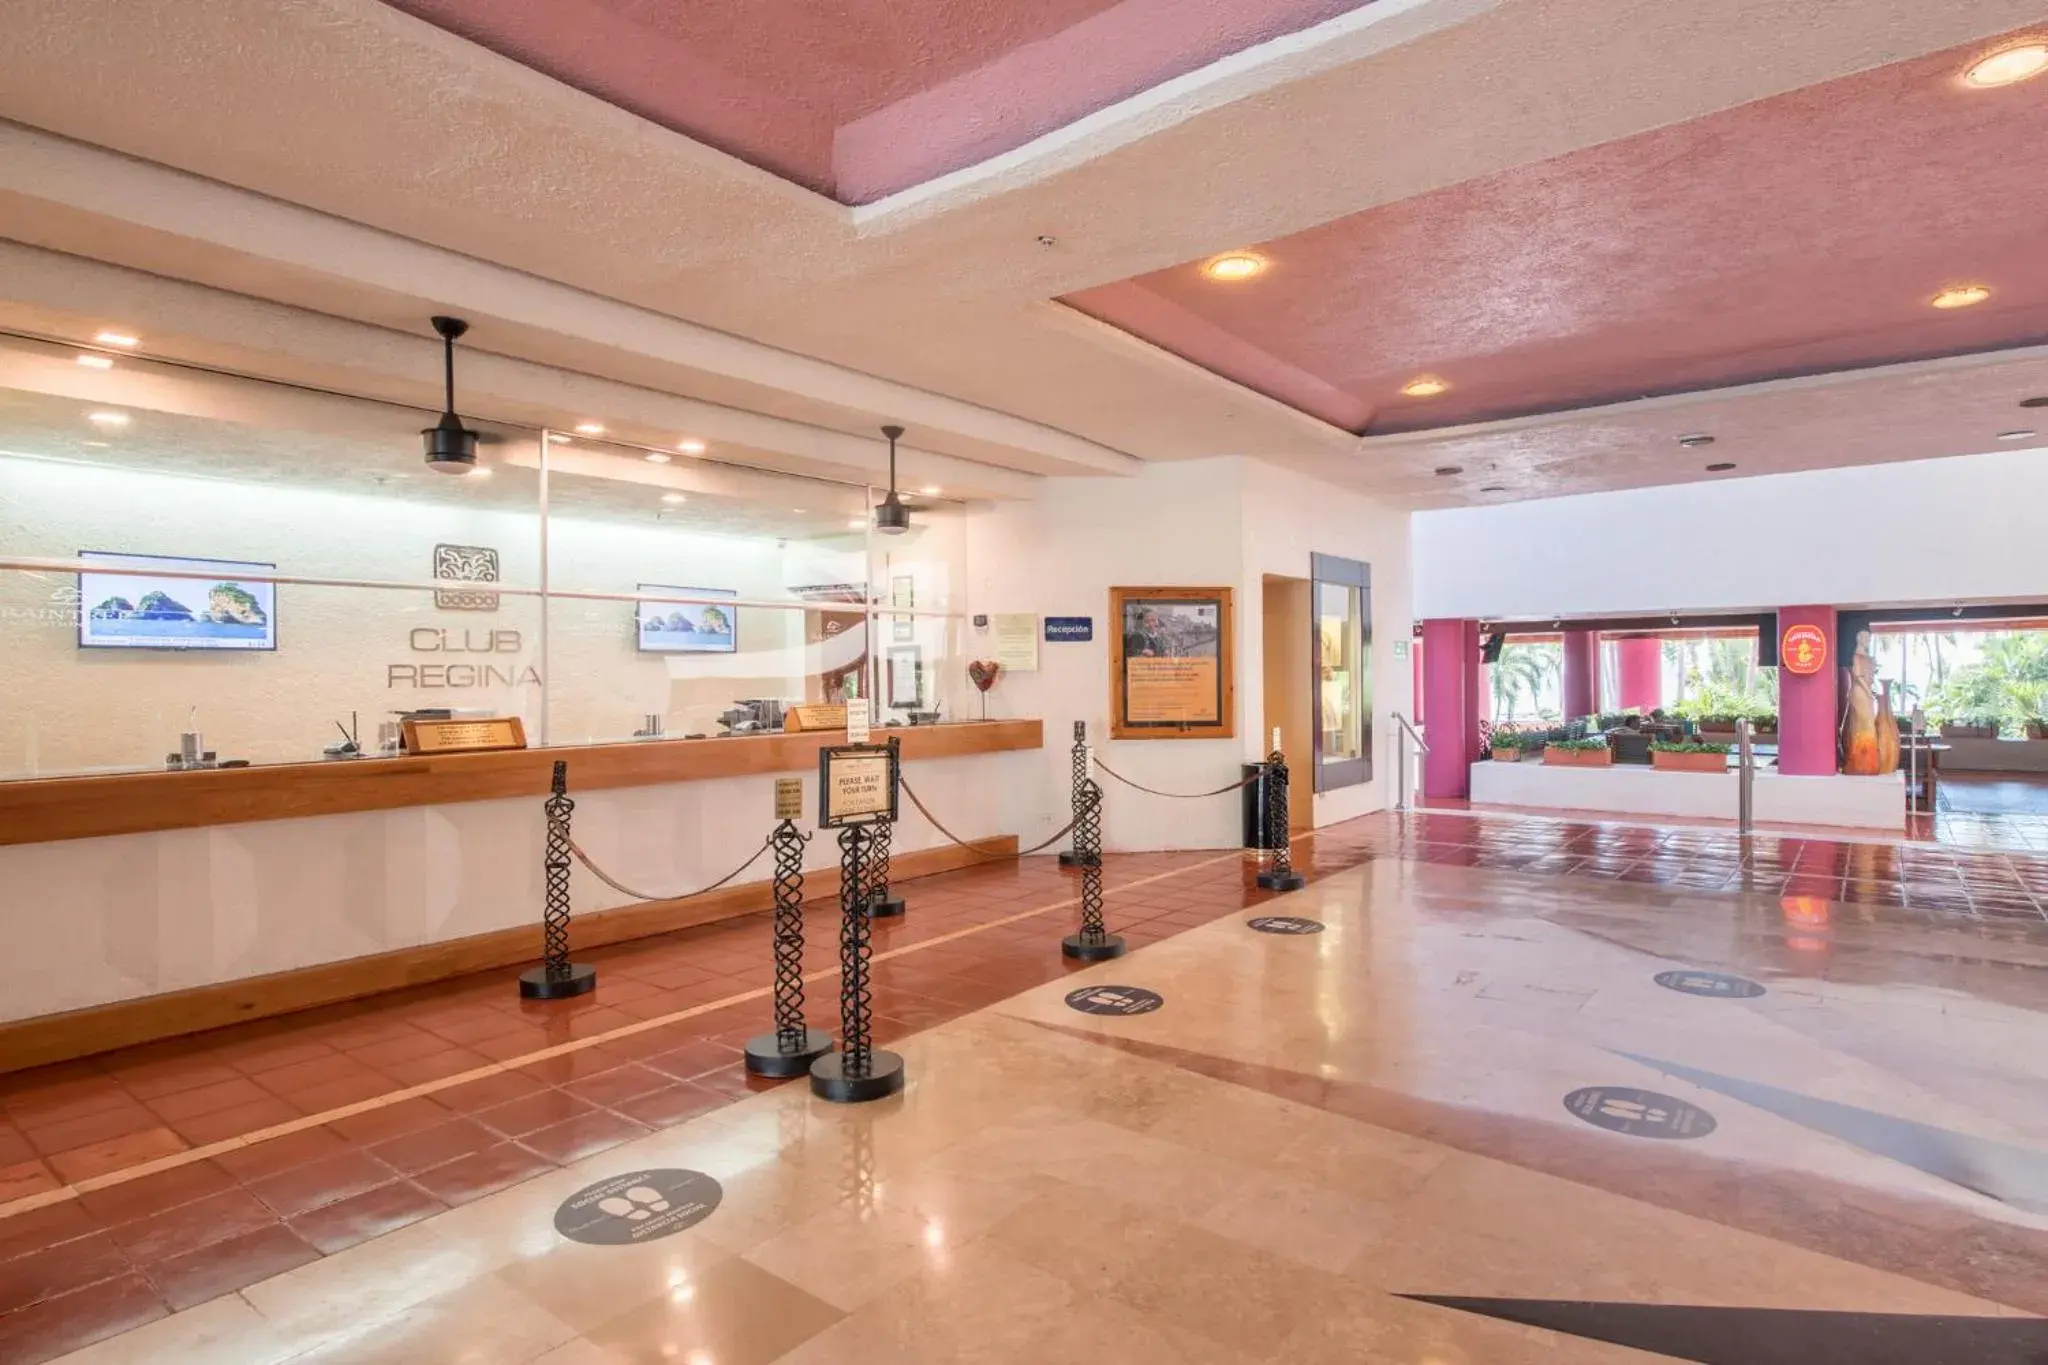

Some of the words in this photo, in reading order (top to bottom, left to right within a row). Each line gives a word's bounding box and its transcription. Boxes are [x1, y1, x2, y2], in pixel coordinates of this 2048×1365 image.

[1047, 624, 1090, 636] Recepción
[409, 627, 522, 653] CLUB
[387, 663, 542, 688] REGINA
[839, 776, 863, 786] PLEASE
